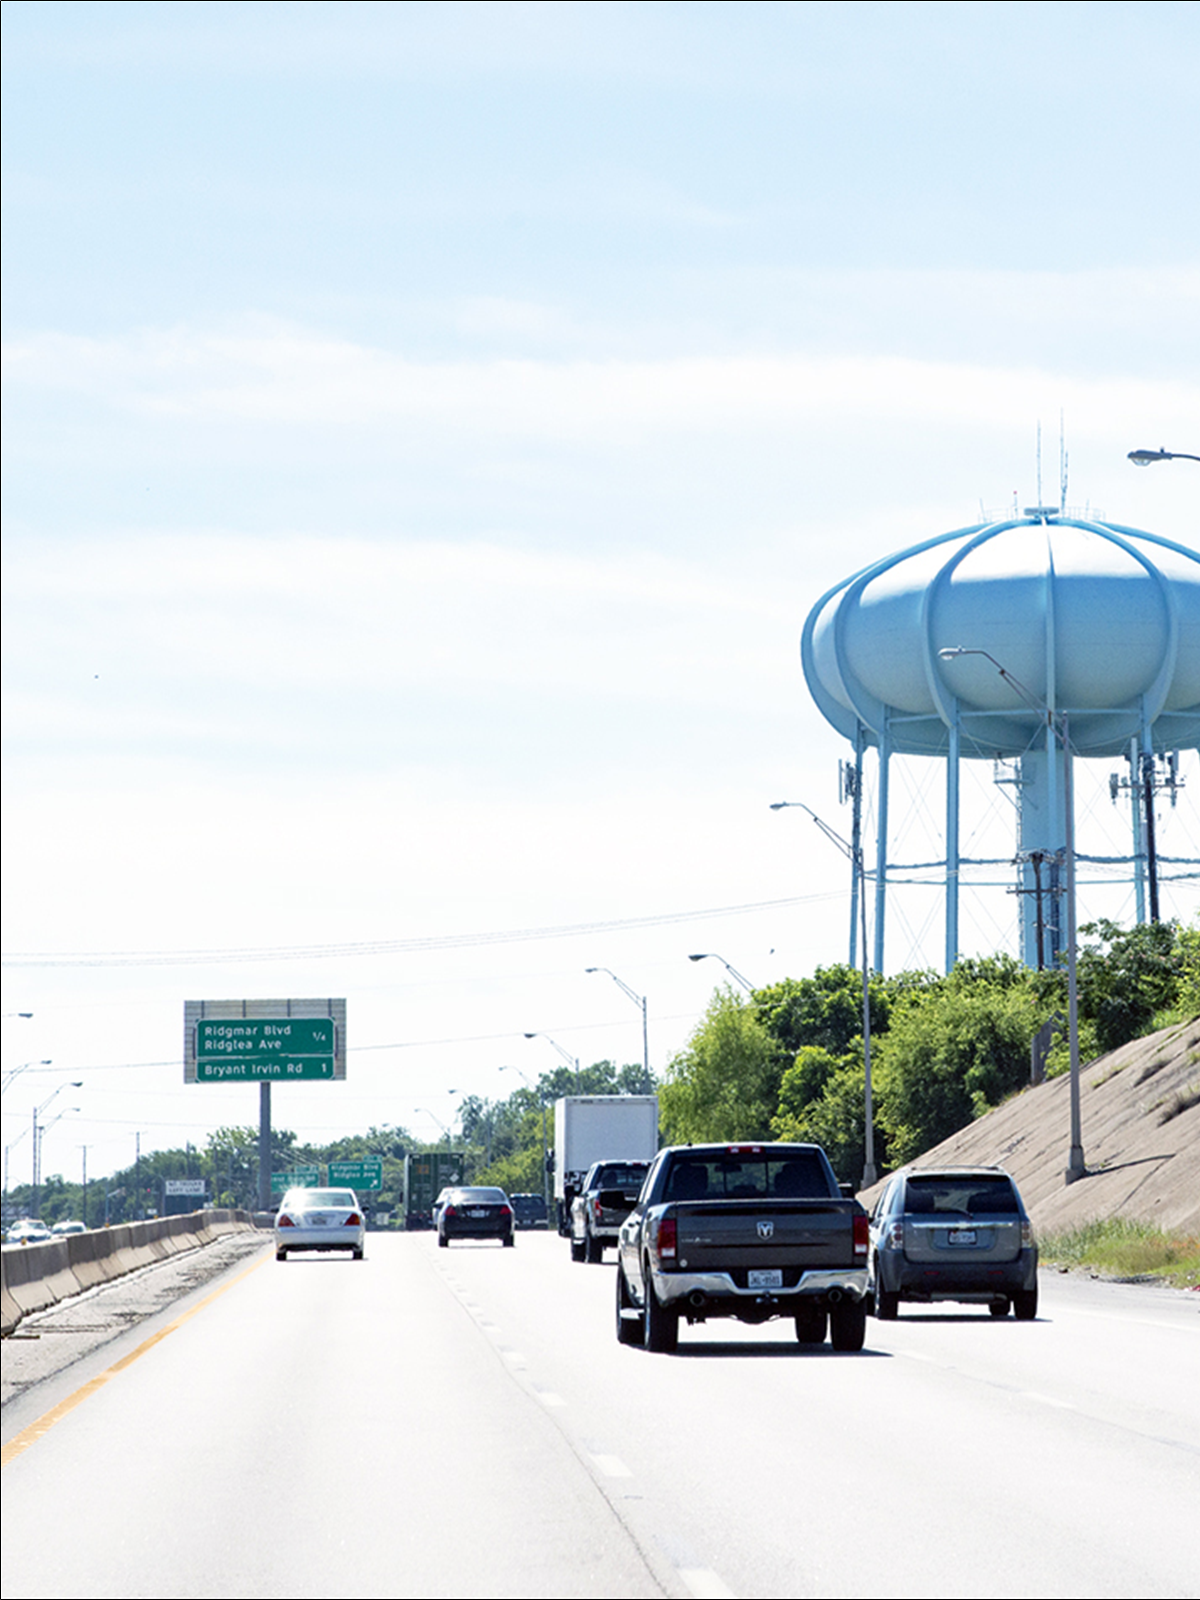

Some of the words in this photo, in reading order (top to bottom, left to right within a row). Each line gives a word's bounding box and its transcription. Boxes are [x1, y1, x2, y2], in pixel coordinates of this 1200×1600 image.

[204, 1026, 257, 1038] Ridgmar
[264, 1025, 291, 1035] Blvd
[204, 1040, 253, 1052] Ridglea
[259, 1040, 282, 1049] Ave
[205, 1065, 246, 1077] Bryant
[252, 1064, 281, 1074] Irvin
[287, 1064, 303, 1073] Rd
